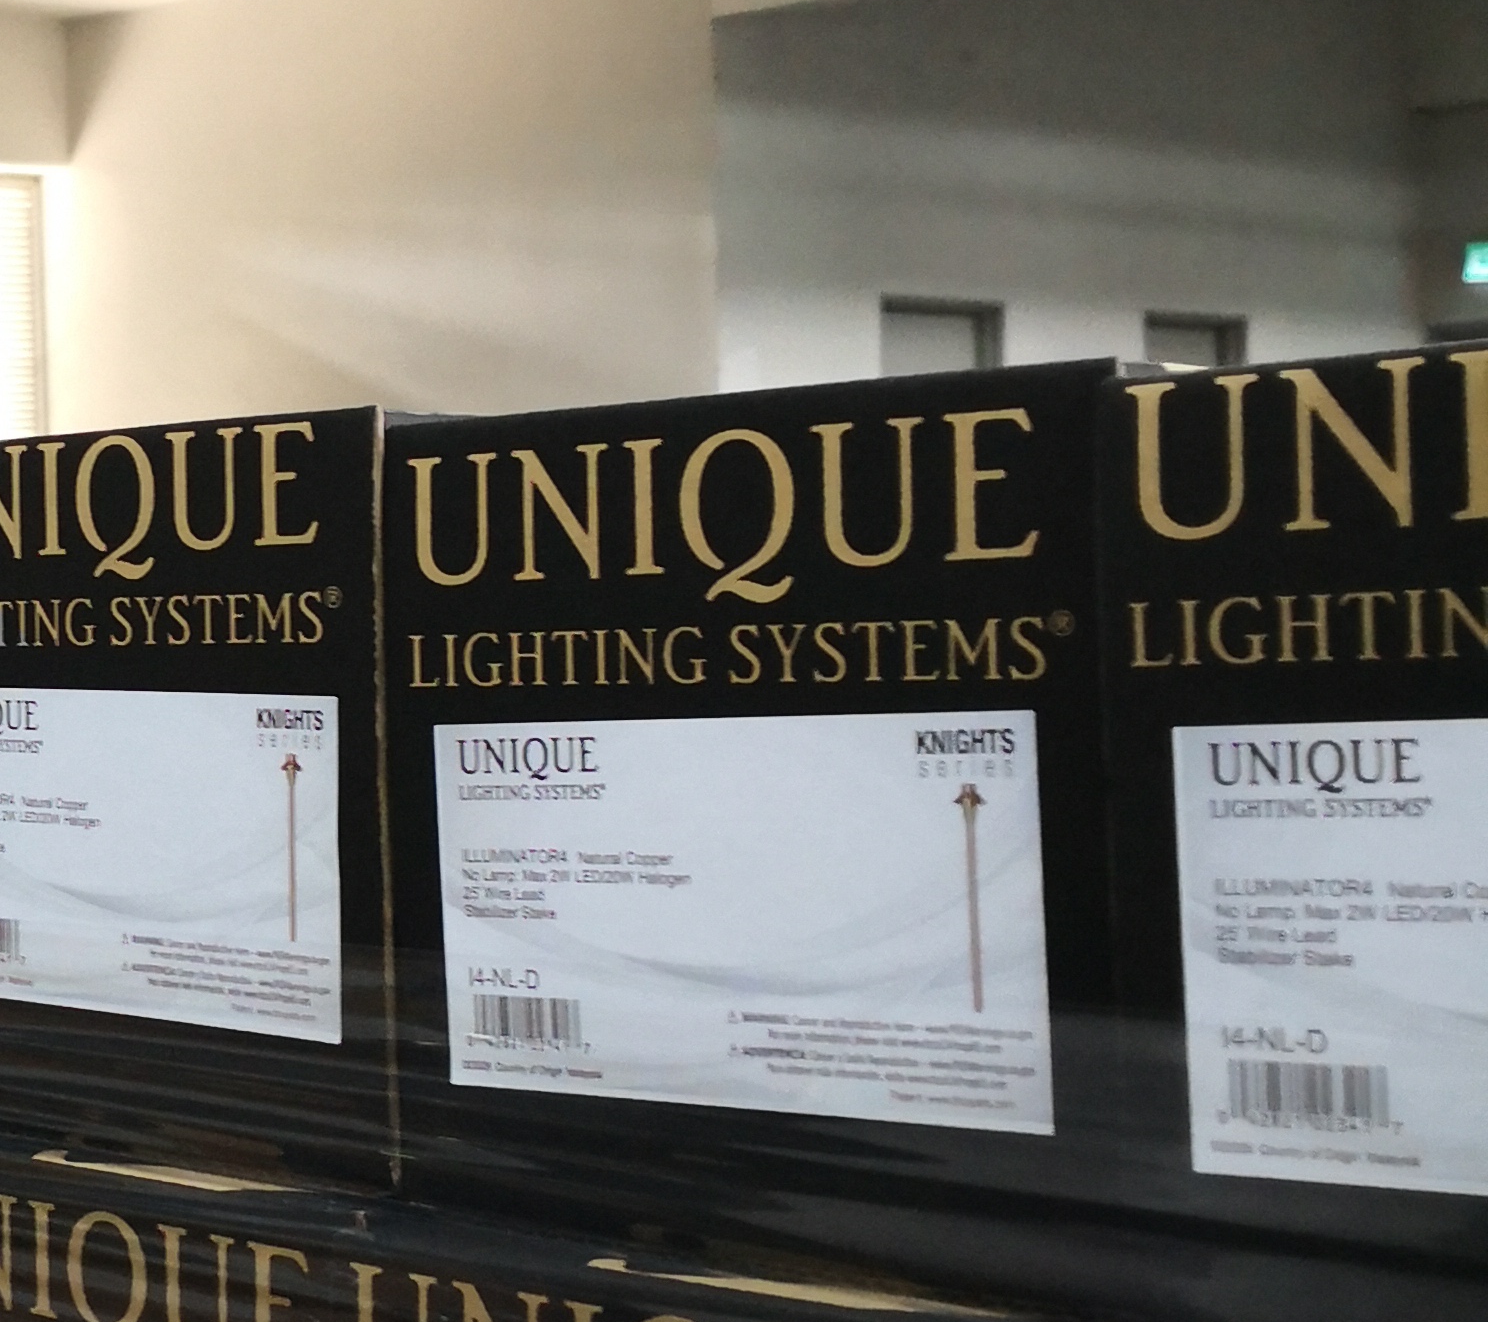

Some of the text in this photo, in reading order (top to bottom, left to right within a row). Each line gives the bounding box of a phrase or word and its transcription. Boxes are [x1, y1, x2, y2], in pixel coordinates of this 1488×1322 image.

[406, 407, 1040, 602] UNIQUE
[409, 625, 708, 689] LIGHTING
[256, 708, 324, 731] KNIGHTS
[915, 728, 1015, 755] KNIGHTS
[455, 736, 599, 781] UNIQUE
[1208, 738, 1422, 793] UNIQUE
[1210, 798, 1317, 818] LIGHTING
